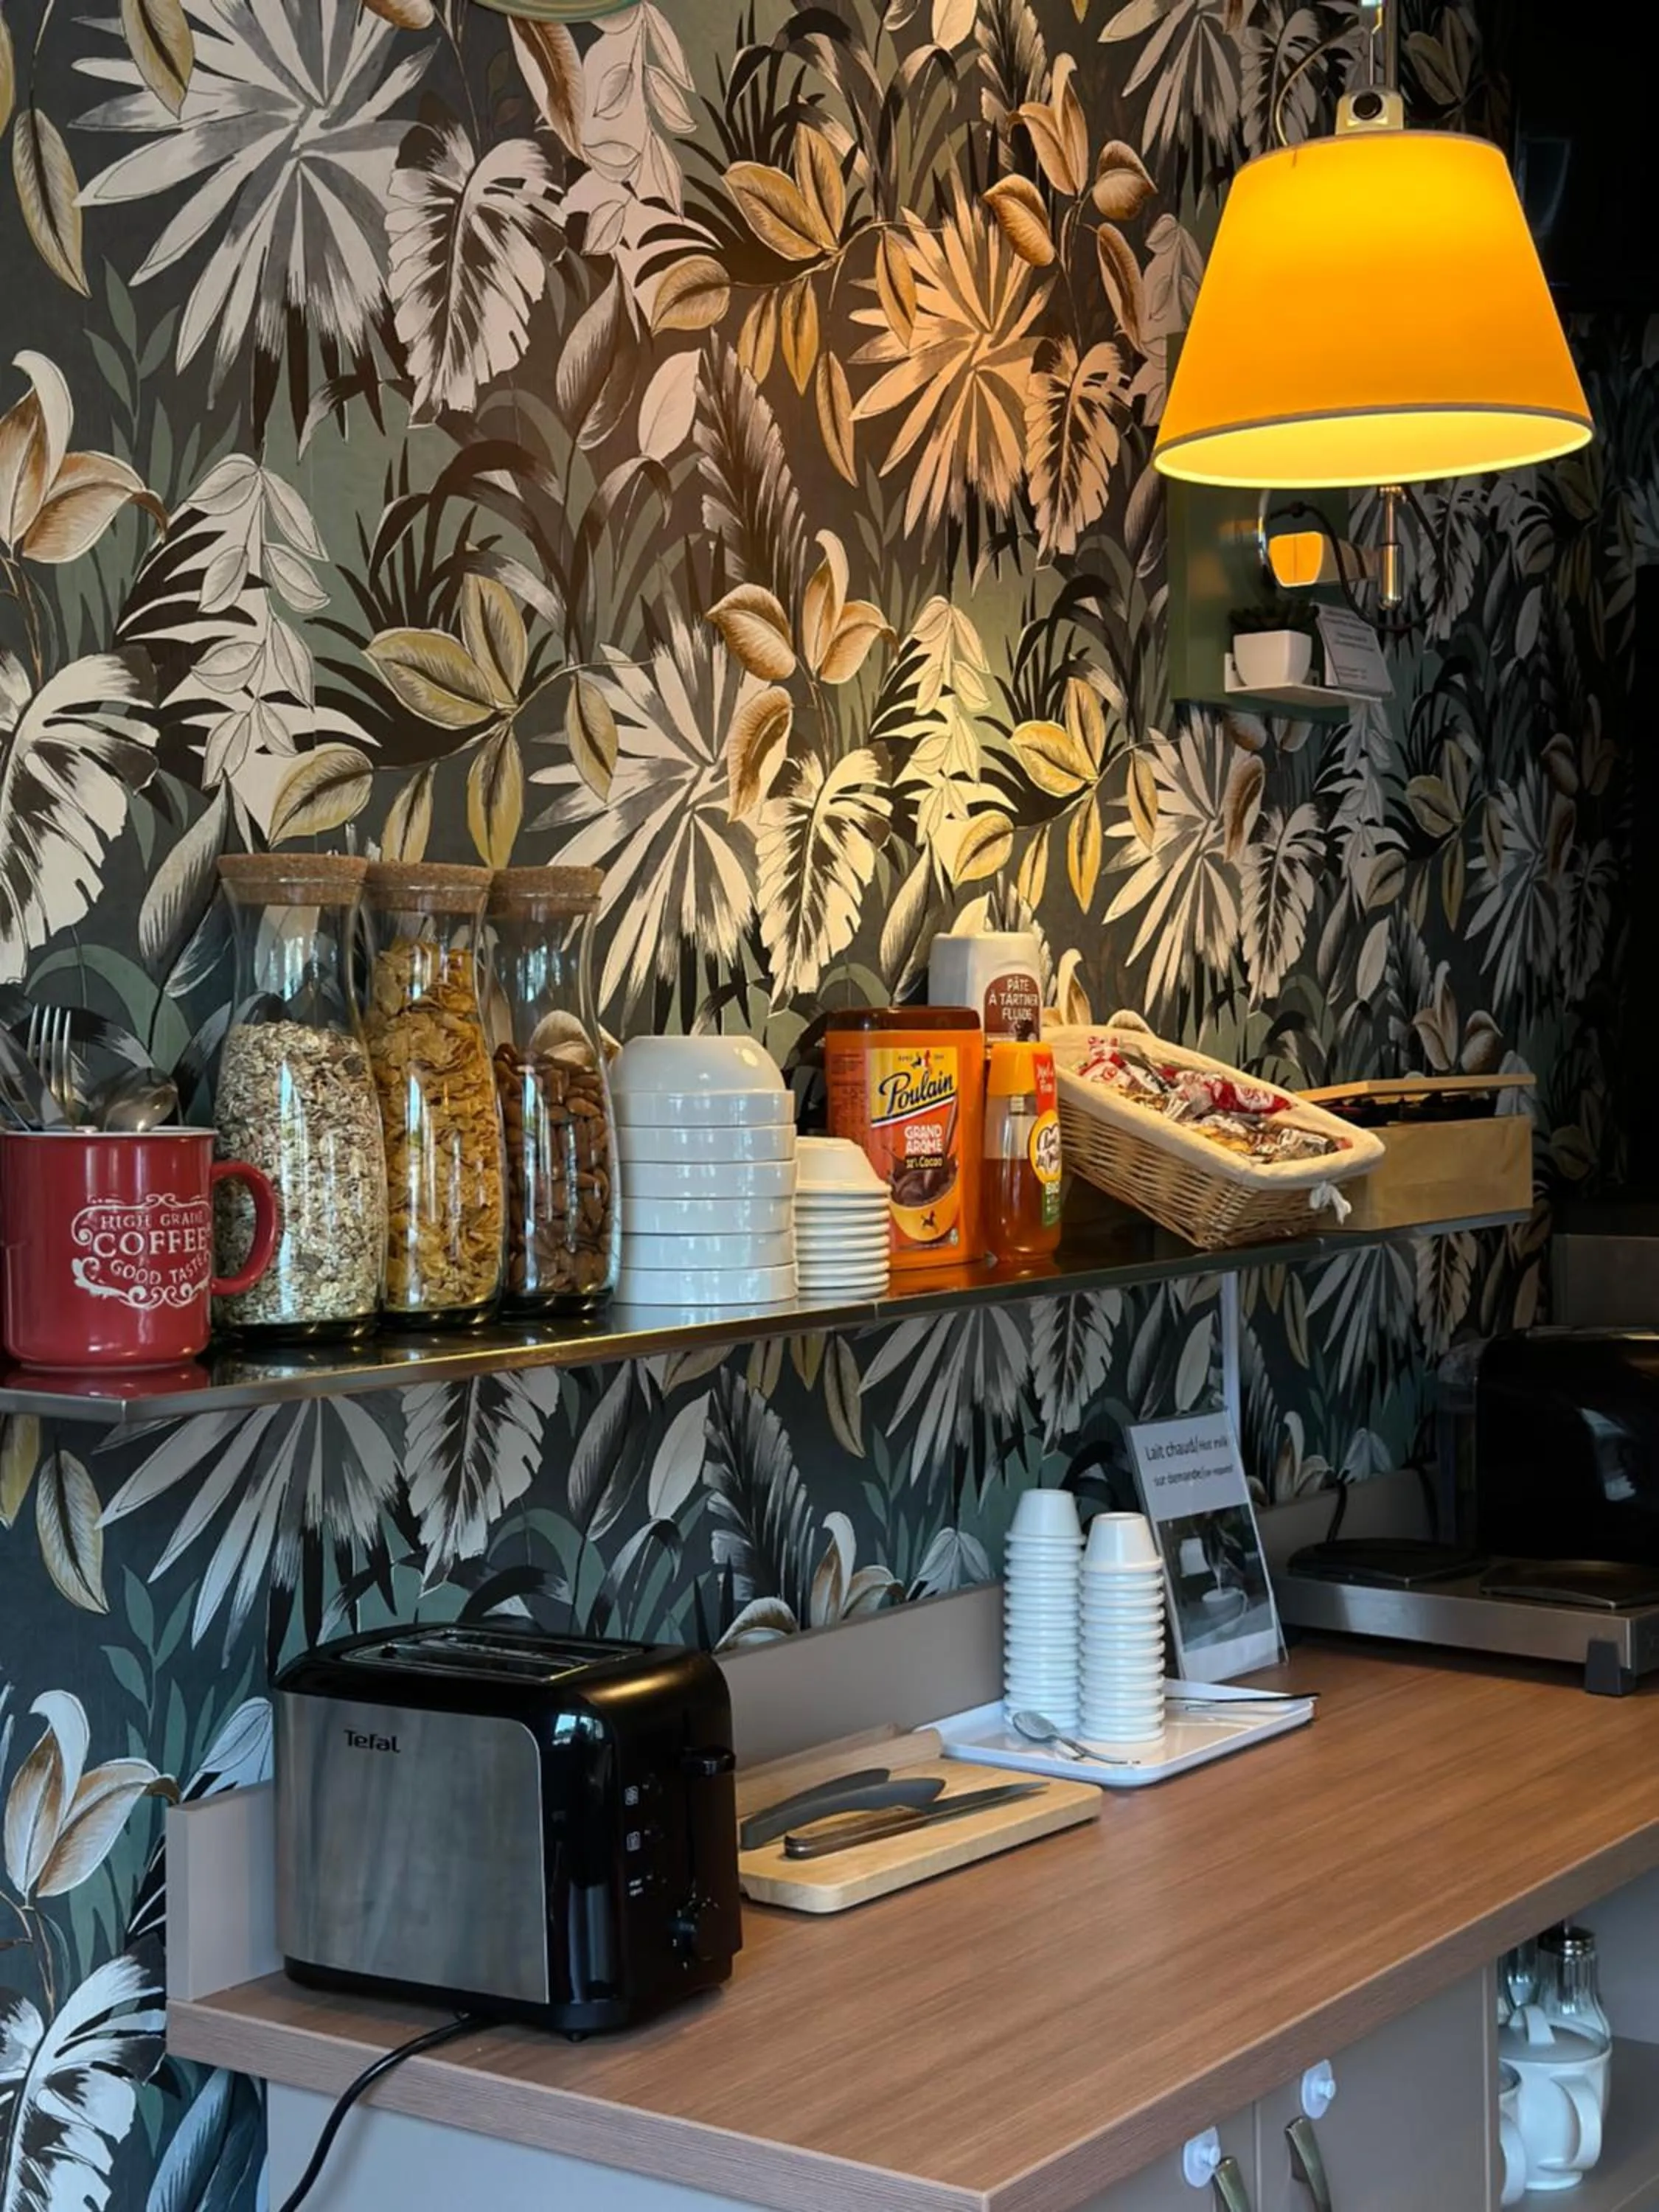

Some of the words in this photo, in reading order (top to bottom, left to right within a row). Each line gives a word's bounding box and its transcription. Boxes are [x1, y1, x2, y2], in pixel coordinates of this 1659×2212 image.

[878, 1070, 953, 1115] Poulain
[904, 1124, 942, 1139] GRAND
[100, 1213, 150, 1230] HIGH
[93, 1227, 207, 1258] COFFEE
[110, 1259, 161, 1285] GOOD
[344, 1729, 401, 1753] Tefal
